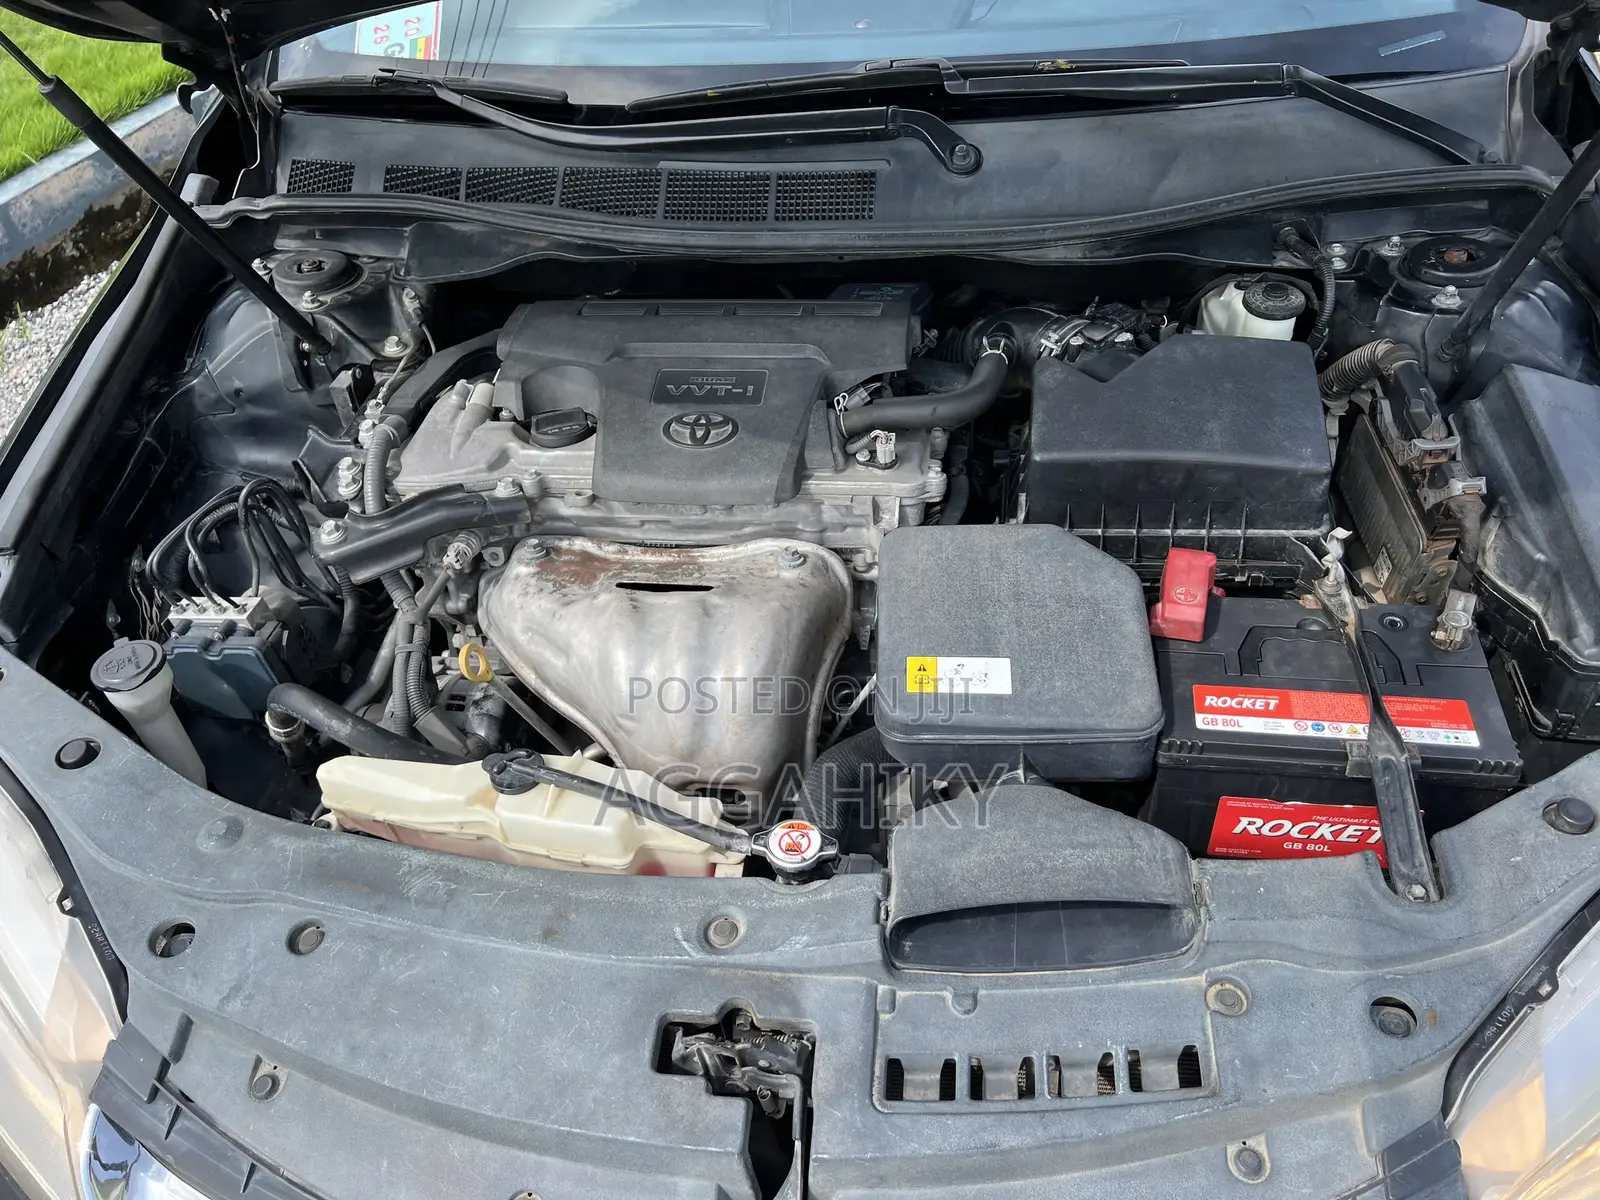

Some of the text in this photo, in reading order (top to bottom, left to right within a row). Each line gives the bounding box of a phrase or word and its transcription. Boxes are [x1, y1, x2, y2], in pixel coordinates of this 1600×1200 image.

[373, 24, 390, 45] 26
[404, 16, 421, 37] 20
[1203, 695, 1279, 711] ROCKET
[1202, 717, 1244, 728] GB 80L
[1329, 816, 1368, 824] ULTIMATE
[1231, 816, 1382, 844] ROCKET
[1283, 841, 1332, 852] GB 80L
